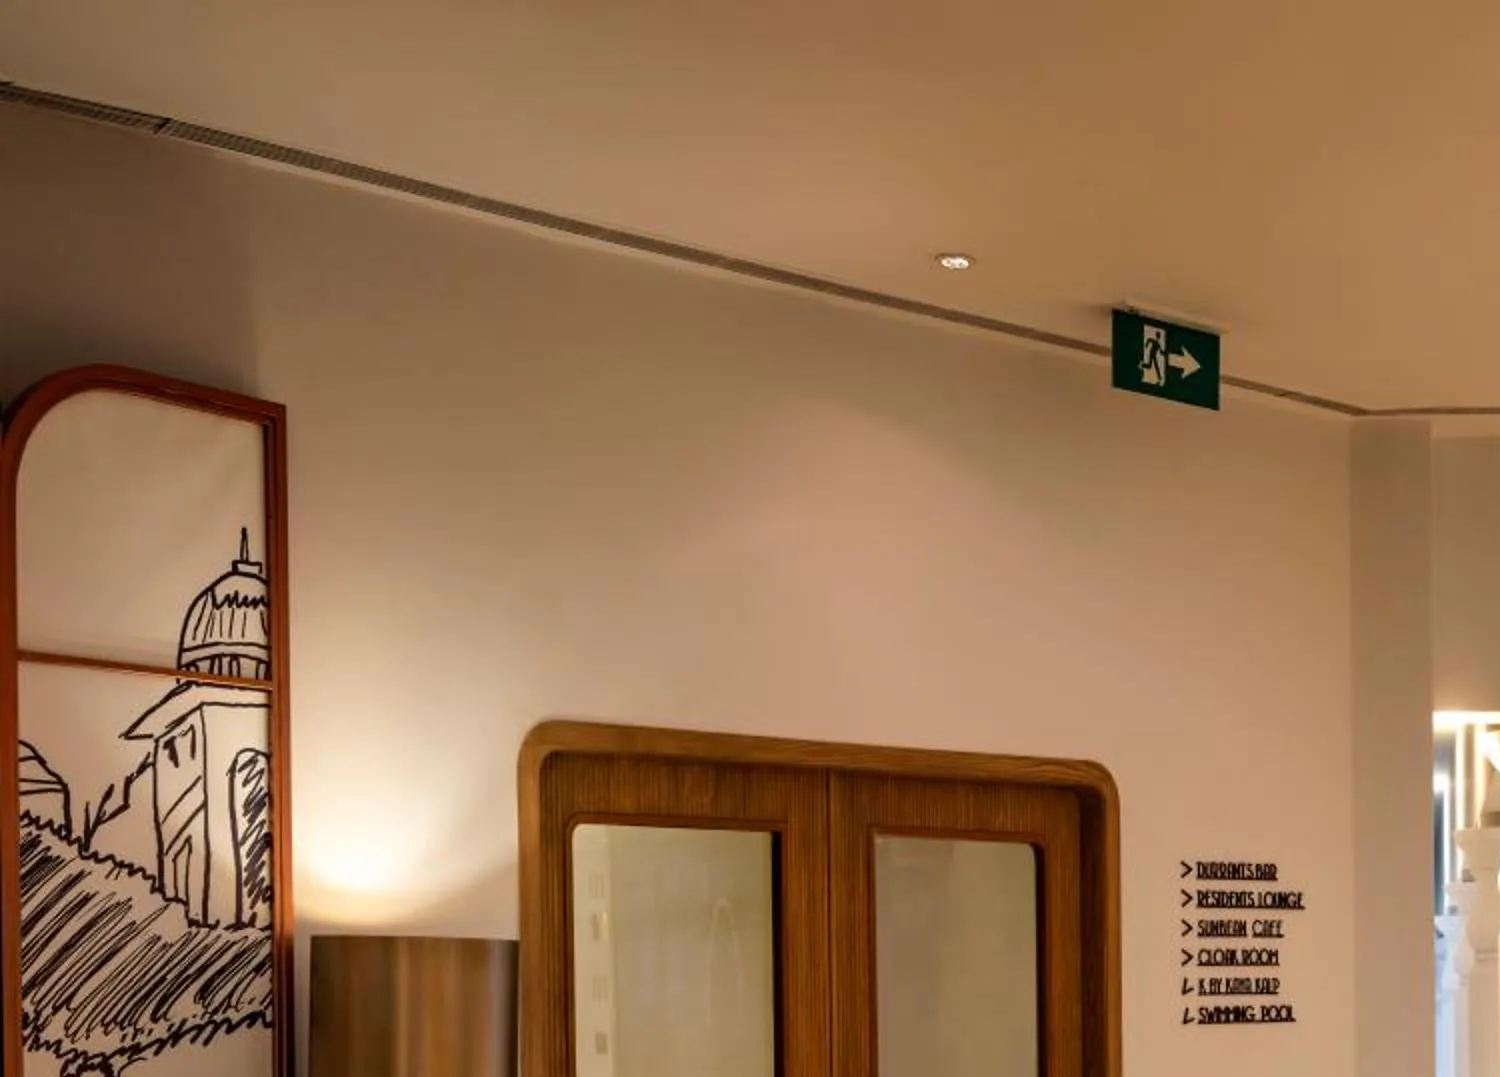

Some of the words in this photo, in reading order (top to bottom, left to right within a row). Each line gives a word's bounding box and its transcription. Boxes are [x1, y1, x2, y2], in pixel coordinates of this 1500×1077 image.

[1255, 863, 1278, 881] BAR
[1197, 890, 1255, 908] RESIDENTS
[1257, 891, 1305, 910] LOUNGE
[1197, 948, 1239, 966] CLOAK
[1241, 948, 1280, 966] ROOM
[1198, 1005, 1256, 1024] SWIMMING
[1260, 1004, 1296, 1023] POOL
